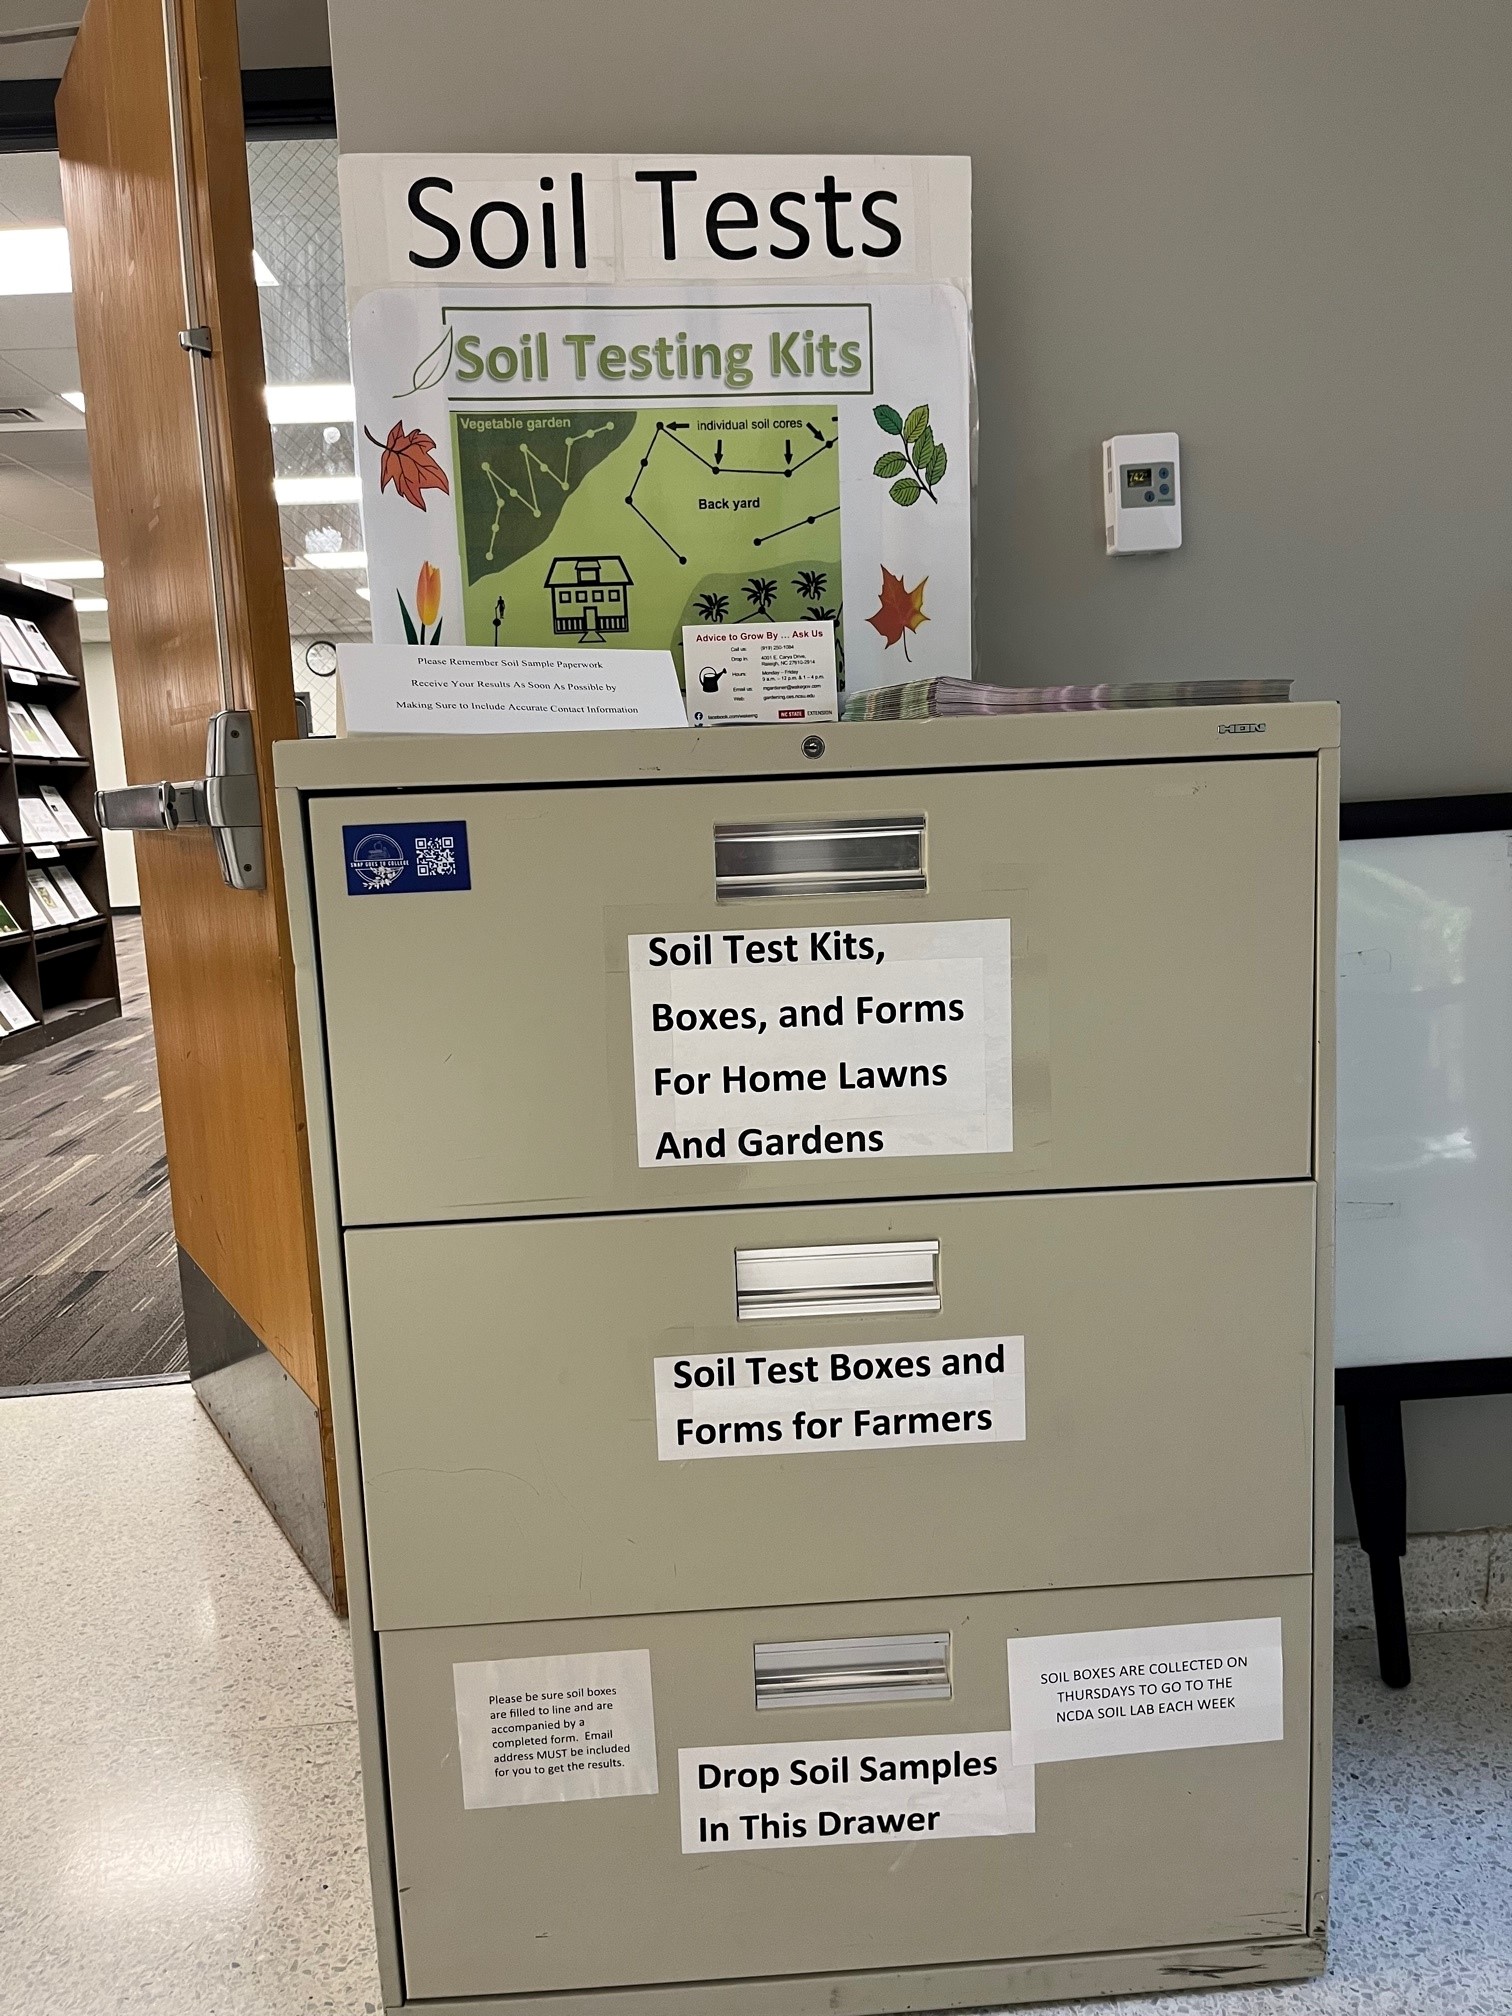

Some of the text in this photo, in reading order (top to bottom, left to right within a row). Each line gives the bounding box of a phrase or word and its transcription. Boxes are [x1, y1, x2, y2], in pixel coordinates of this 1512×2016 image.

[407, 170, 904, 270] Soil Tests
[455, 330, 863, 389] Soil Testing Kits
[461, 417, 571, 433] Vegetable garden
[697, 419, 803, 431] individual soil cores
[698, 497, 761, 510] Back yard
[696, 633, 727, 642] Advice
[729, 633, 738, 641] to
[740, 632, 764, 640] Grow
[767, 631, 778, 641] By
[812, 630, 823, 638] Us
[417, 657, 604, 670] Please Remember Soil Sample Paperwork
[411, 679, 617, 693] Receive Your Results As Soon As Possible by
[396, 701, 433, 710] Making
[459, 702, 469, 710] to
[471, 703, 506, 711] Include
[508, 704, 549, 712] Accurate
[551, 705, 585, 713] Contact
[587, 706, 639, 714] Information
[1217, 723, 1266, 734] HON
[648, 930, 886, 968] Soil Test Kits,
[652, 996, 965, 1035] Boxes, and Forms
[654, 1061, 948, 1096] For Home Lawns
[656, 1125, 885, 1160] And Gardens
[674, 1344, 1005, 1389] Soil Test Boxes and
[677, 1408, 993, 1445] Forms for Farmers
[1041, 1656, 1248, 1685] SOIL BOXES ARE COLLECTED ON
[489, 1687, 617, 1705] Please be sure soil boxes
[1057, 1677, 1233, 1703] THURSDAYS TO GO TO THE
[490, 1702, 614, 1720] are filled to line and are
[1056, 1697, 1235, 1723] NCDA SOIL LAB EACH WEEK
[492, 1719, 585, 1734] accompanied by a
[492, 1730, 613, 1749] completed form. Email
[494, 1744, 630, 1763] address MUST be included
[495, 1759, 625, 1777] for you to get the results.
[698, 1751, 998, 1794] Drop Soil Samples
[699, 1810, 941, 1842] In This Drawer
